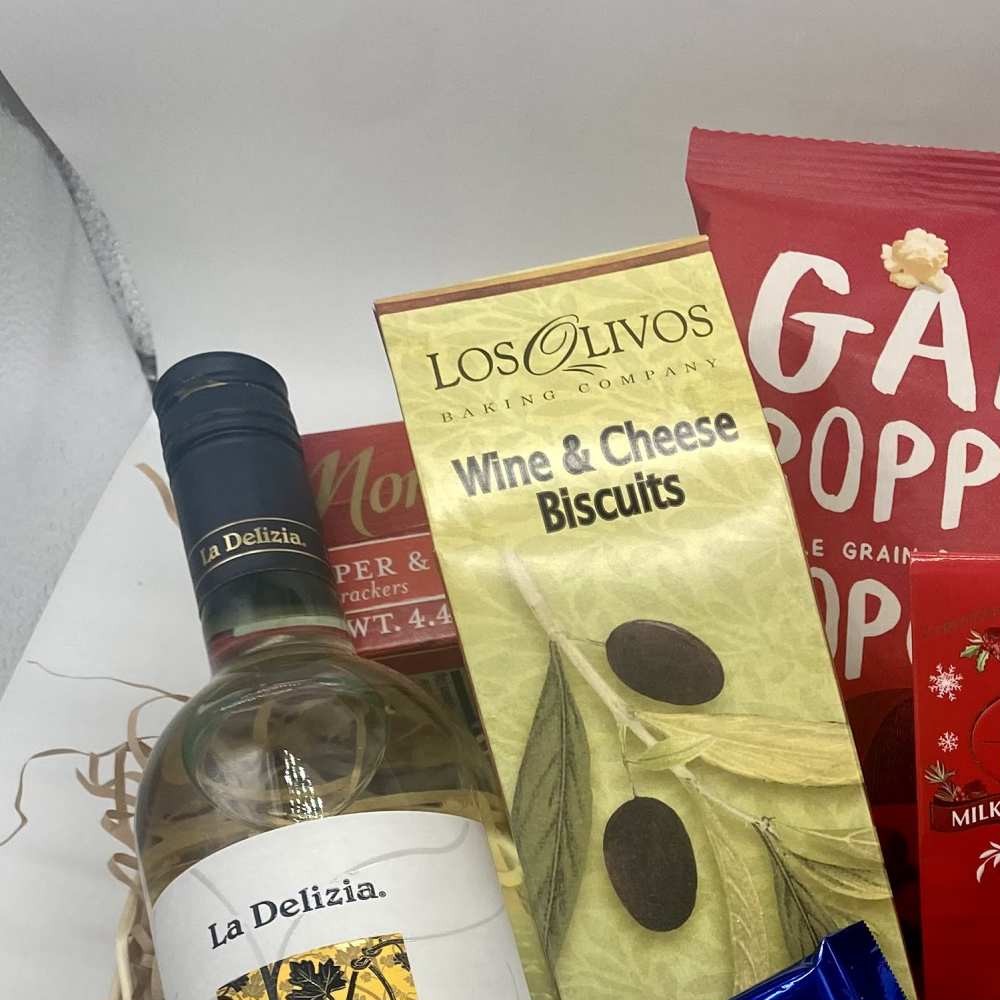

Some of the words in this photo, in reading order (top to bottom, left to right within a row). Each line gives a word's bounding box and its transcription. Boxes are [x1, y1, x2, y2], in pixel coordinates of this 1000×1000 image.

[426, 341, 521, 391] LOS
[441, 390, 557, 424] BAKING
[577, 357, 720, 395] COMPANY
[451, 449, 553, 498] Wine
[562, 433, 597, 476] &
[599, 410, 740, 467] Cheese
[536, 471, 687, 534] Biscuits
[408, 551, 431, 572] &
[208, 919, 244, 950] La
